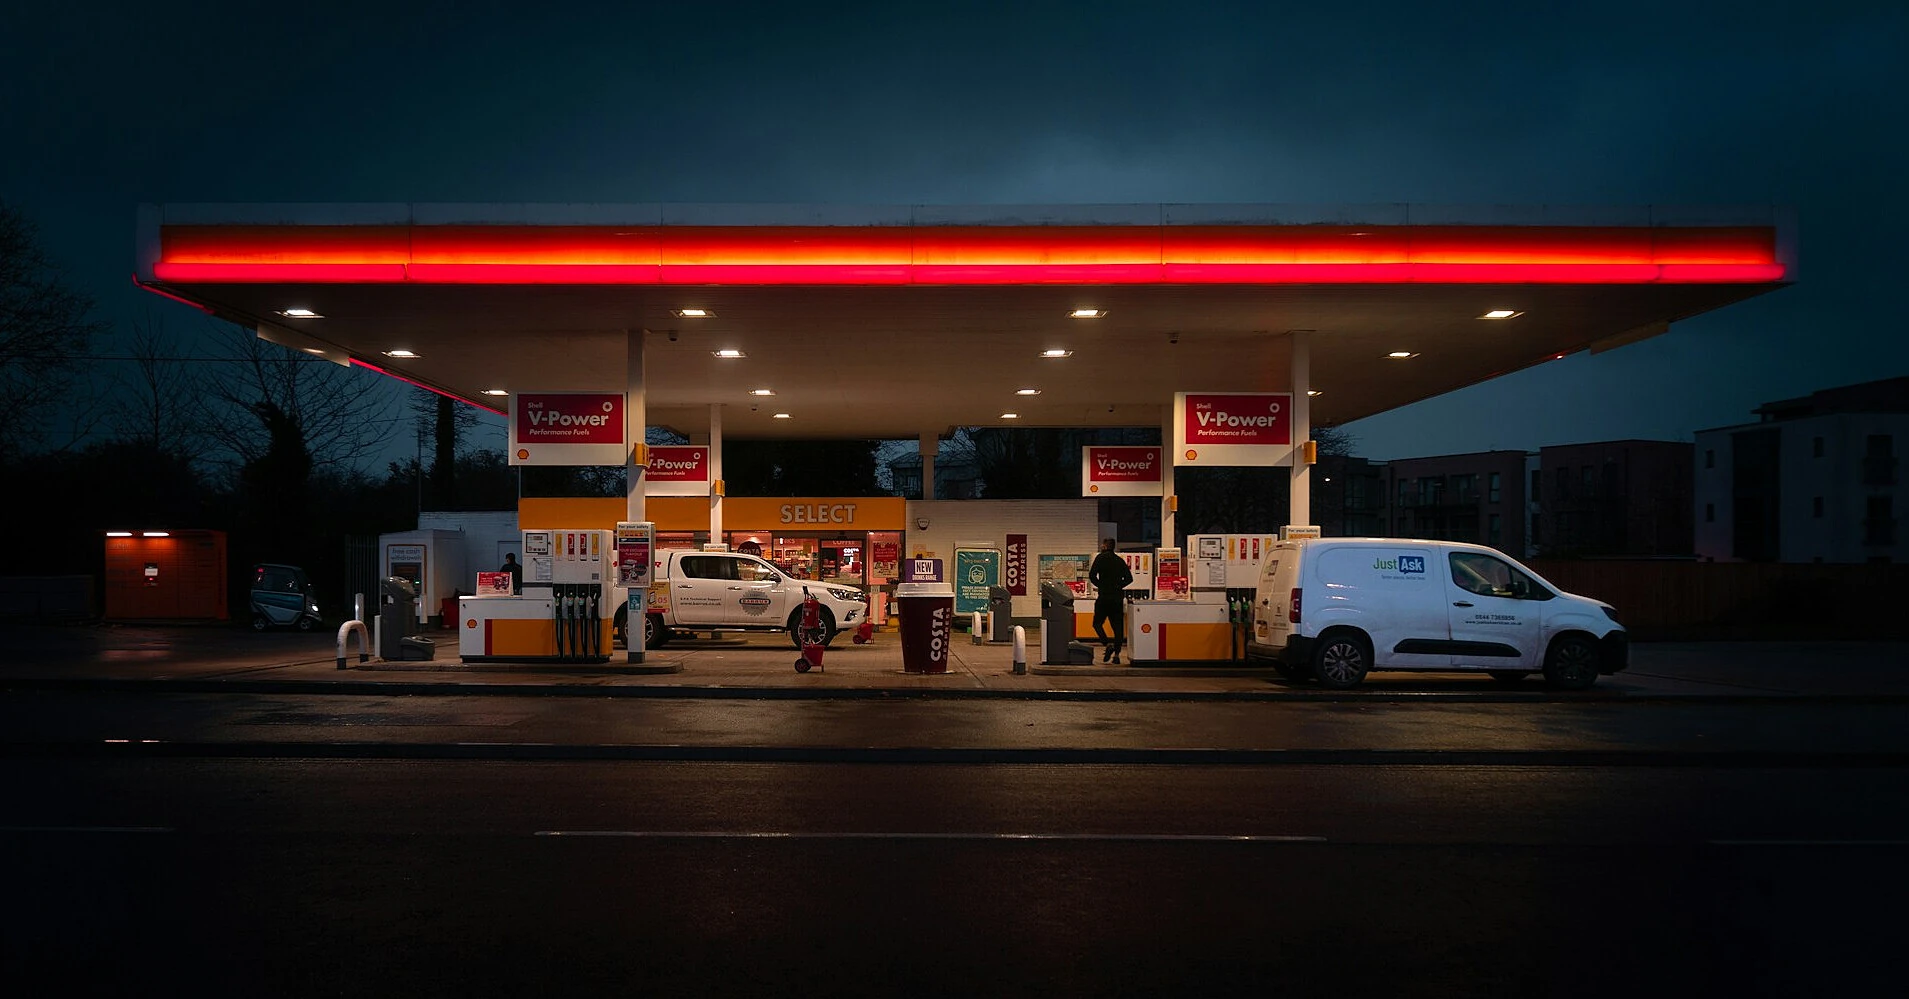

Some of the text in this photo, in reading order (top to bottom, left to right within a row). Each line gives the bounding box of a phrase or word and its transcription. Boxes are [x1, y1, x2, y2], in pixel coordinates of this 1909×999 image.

[528, 410, 609, 426] V-Power
[1196, 411, 1276, 427] V-Power
[529, 428, 590, 436] Performance Fuels
[1197, 429, 1257, 437] Performance Fuels
[1097, 459, 1151, 469] V-Power
[780, 504, 857, 523] SELECT
[916, 561, 932, 573] NEW
[1007, 543, 1019, 587] COSTA
[1373, 558, 1422, 571] Just Ask
[930, 607, 945, 662] COSTA
[942, 607, 951, 653] EXPRESS
